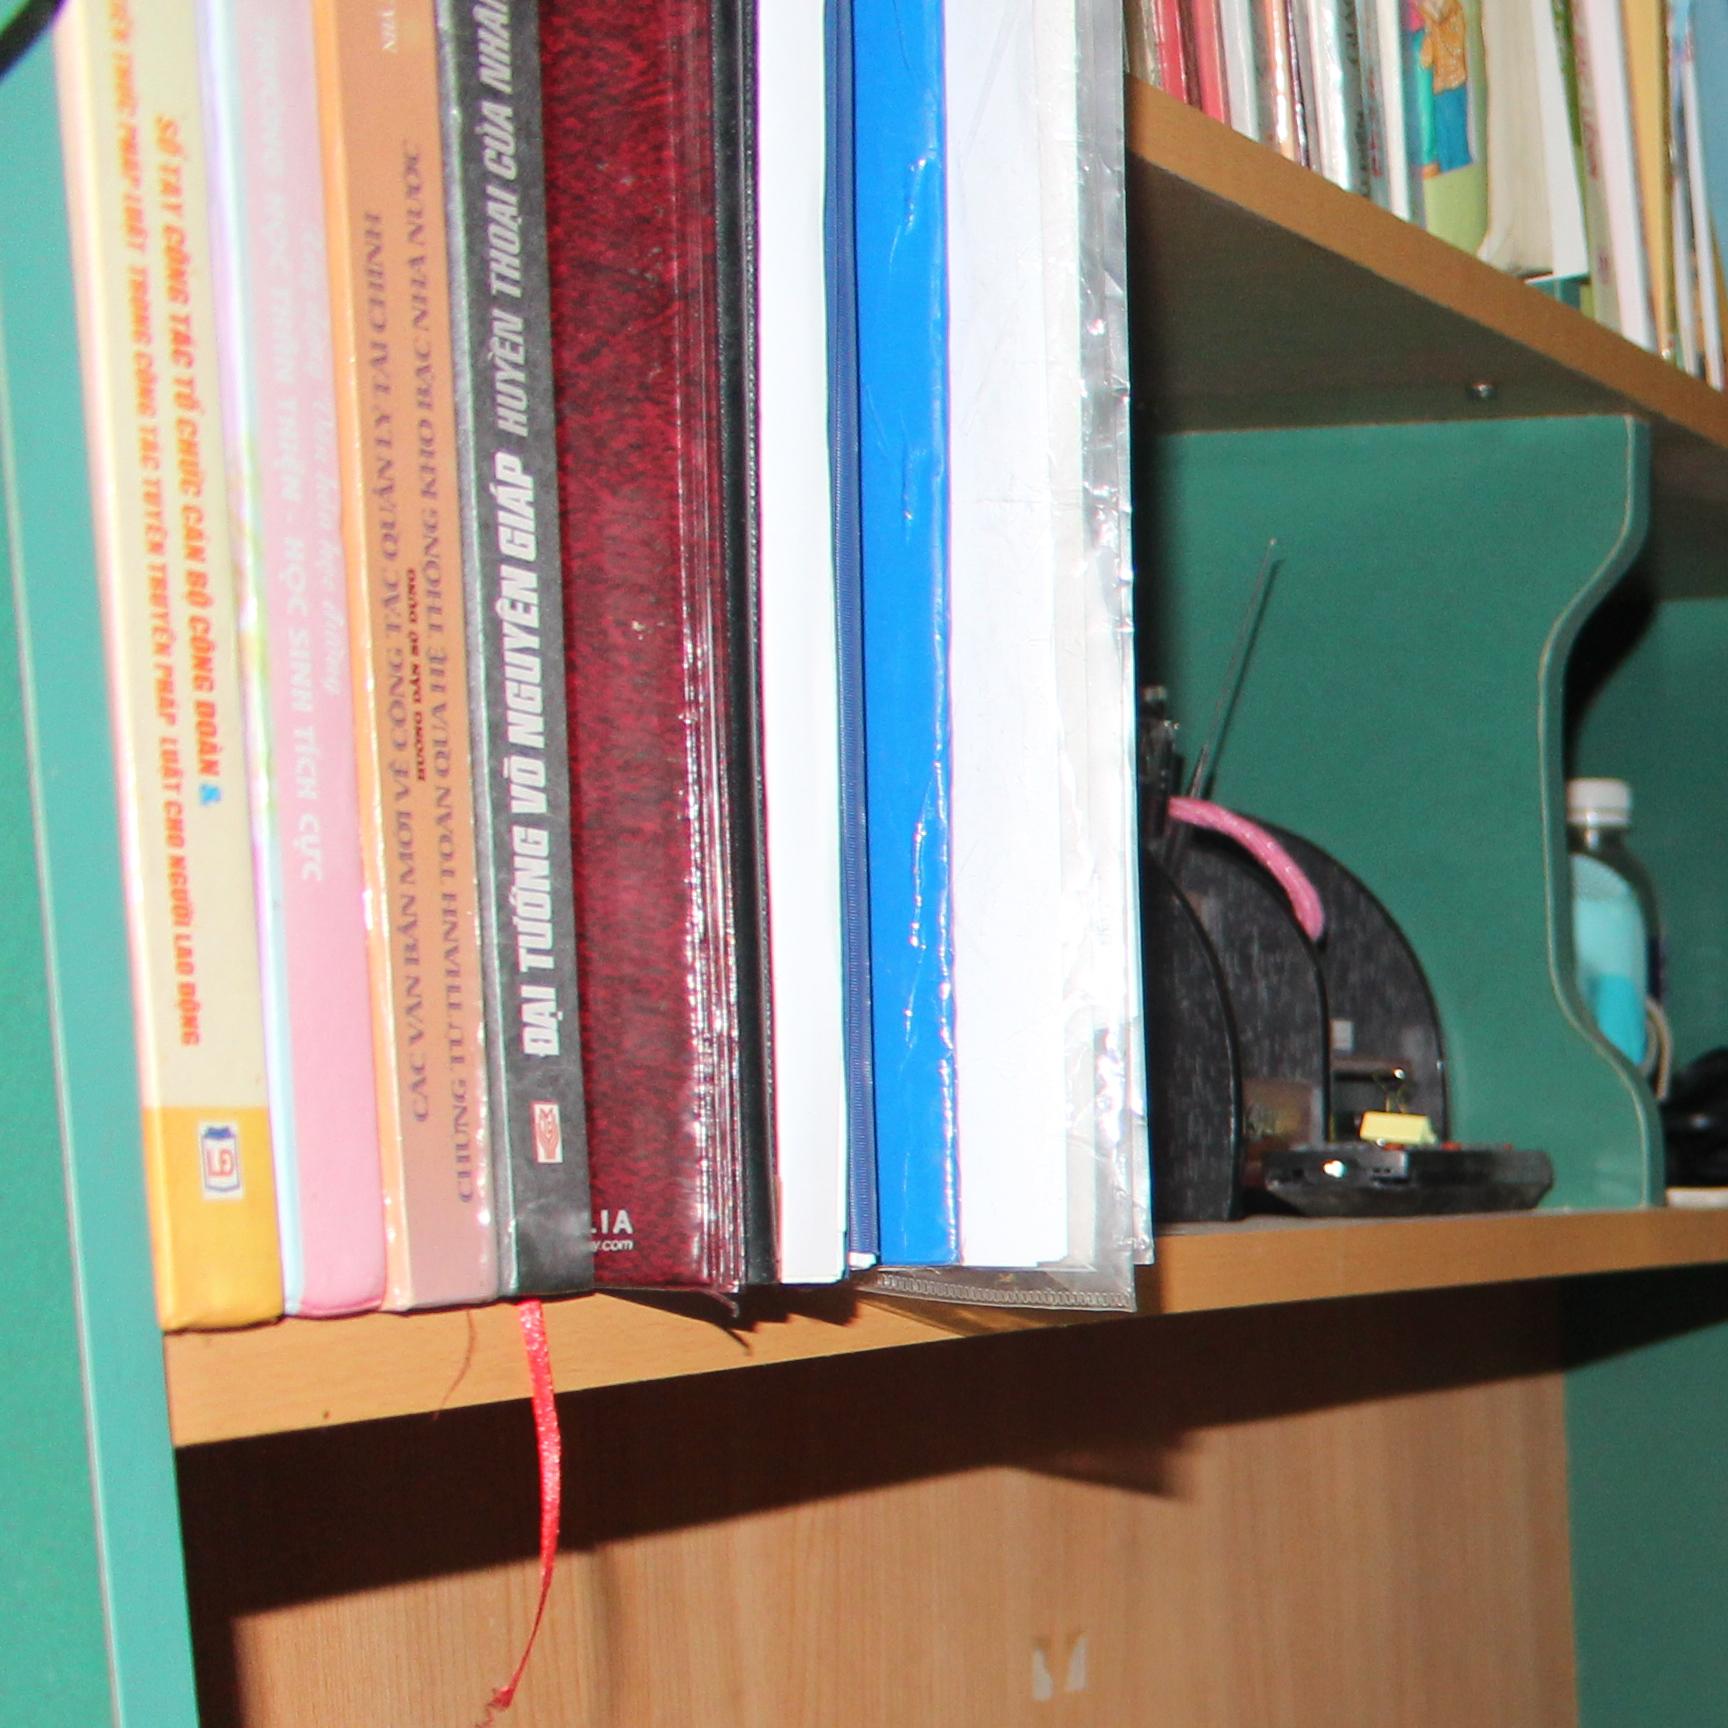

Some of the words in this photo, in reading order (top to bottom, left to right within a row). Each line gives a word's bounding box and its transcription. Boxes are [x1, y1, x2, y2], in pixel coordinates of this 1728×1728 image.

[473, 100, 519, 181] CỦA
[160, 163, 185, 219] TAY
[162, 224, 194, 303] CÔNG
[484, 184, 524, 300] THOẠI
[128, 265, 153, 346] TRONG
[168, 313, 200, 368] TÁC
[270, 288, 300, 385] THÂN
[134, 352, 158, 417] CÔNG
[174, 375, 208, 416] TỔ
[412, 334, 437, 412] BẠC
[486, 306, 530, 438] HUYỀN
[137, 425, 162, 469] TÁC
[175, 417, 208, 497] CHỨC
[274, 396, 307, 500] THIỆN
[415, 419, 441, 502] KHO
[142, 479, 168, 554] TUYÊN
[181, 504, 211, 560] CÁN
[490, 451, 538, 562] GIÁP
[146, 562, 176, 655] TRUYỀN
[182, 570, 217, 607] BỘ
[279, 538, 308, 617] HỌC
[420, 508, 447, 640] THỐNG
[186, 615, 217, 692] CÔNG
[288, 628, 316, 712] SINH
[426, 645, 452, 694] HỆ
[493, 570, 545, 750] NGUYÊN
[154, 663, 179, 725] PHÁP
[383, 648, 409, 750] CÔNG
[159, 736, 186, 794] LUẬT
[194, 701, 223, 776] ĐOÀN
[292, 726, 325, 799] TÍCH
[429, 702, 455, 779] QUA
[500, 755, 549, 815] VÕ
[162, 800, 187, 848] CHO
[293, 814, 325, 881] CỰC
[428, 785, 456, 885] TOÁN
[167, 854, 198, 927] NGƯỜI
[508, 824, 556, 973] TƯỚNG
[172, 934, 196, 975] LAO
[390, 893, 421, 967] BẢN
[439, 893, 464, 1013] THANH
[174, 981, 203, 1046] ĐỘNG
[517, 985, 564, 1057] ĐẠI
[451, 1078, 477, 1204] CHỨNG
[591, 1209, 634, 1234] IA
